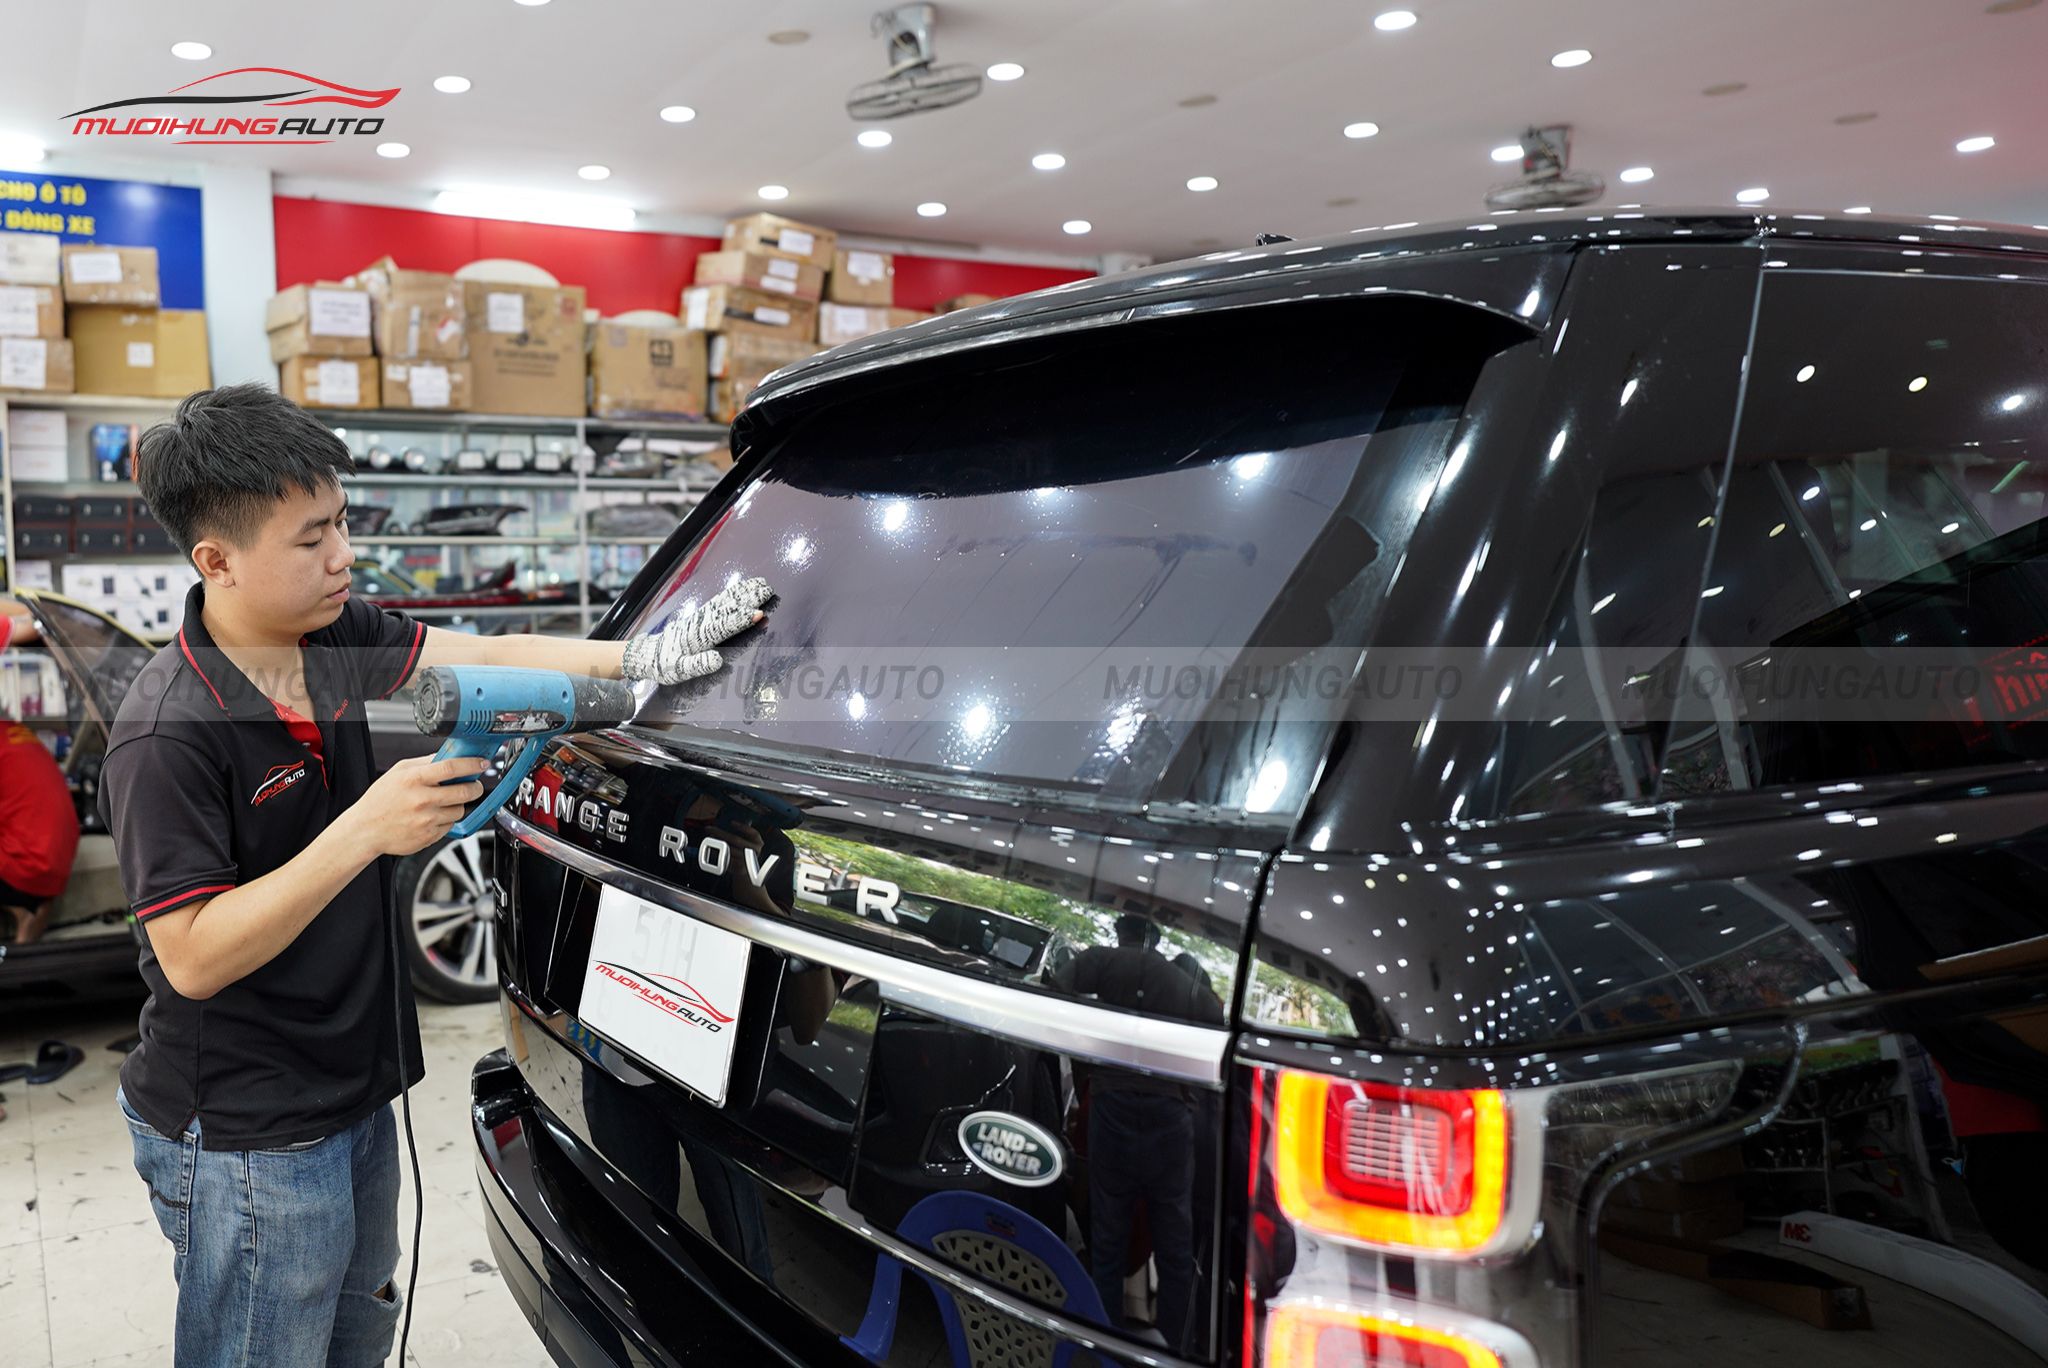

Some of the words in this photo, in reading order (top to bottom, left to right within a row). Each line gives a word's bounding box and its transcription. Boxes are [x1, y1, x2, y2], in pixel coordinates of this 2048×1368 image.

[59, 182, 87, 206] TÔ
[67, 214, 96, 236] XE
[515, 777, 630, 844] RANGE
[658, 825, 900, 925] ROVER
[977, 1122, 1026, 1152] LAND
[981, 1142, 1041, 1175] ROVER
